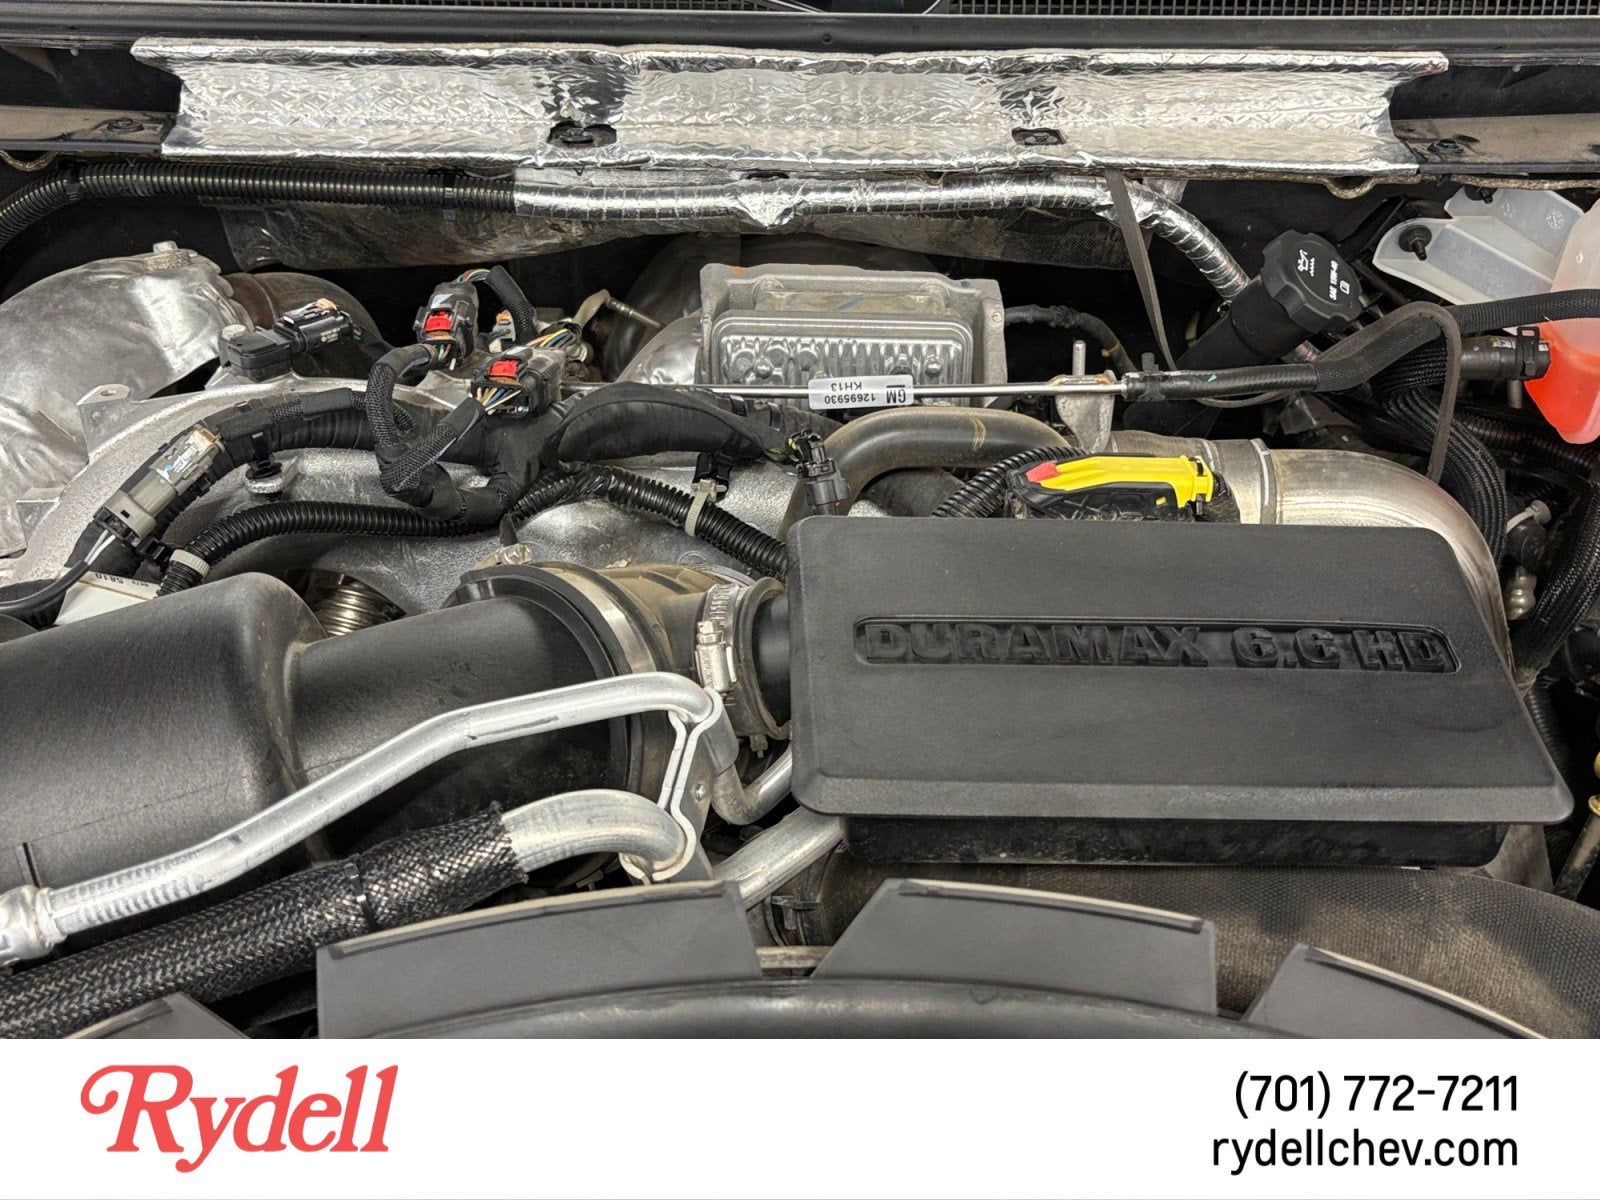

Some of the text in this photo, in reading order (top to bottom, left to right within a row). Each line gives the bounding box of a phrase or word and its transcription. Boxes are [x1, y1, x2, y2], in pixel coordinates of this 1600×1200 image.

[1329, 286, 1337, 300] SAE
[830, 381, 862, 392] KH13
[824, 393, 876, 404] 12695930
[886, 388, 906, 404] GM
[864, 622, 1447, 673] DURAMAX 6.6 HD
